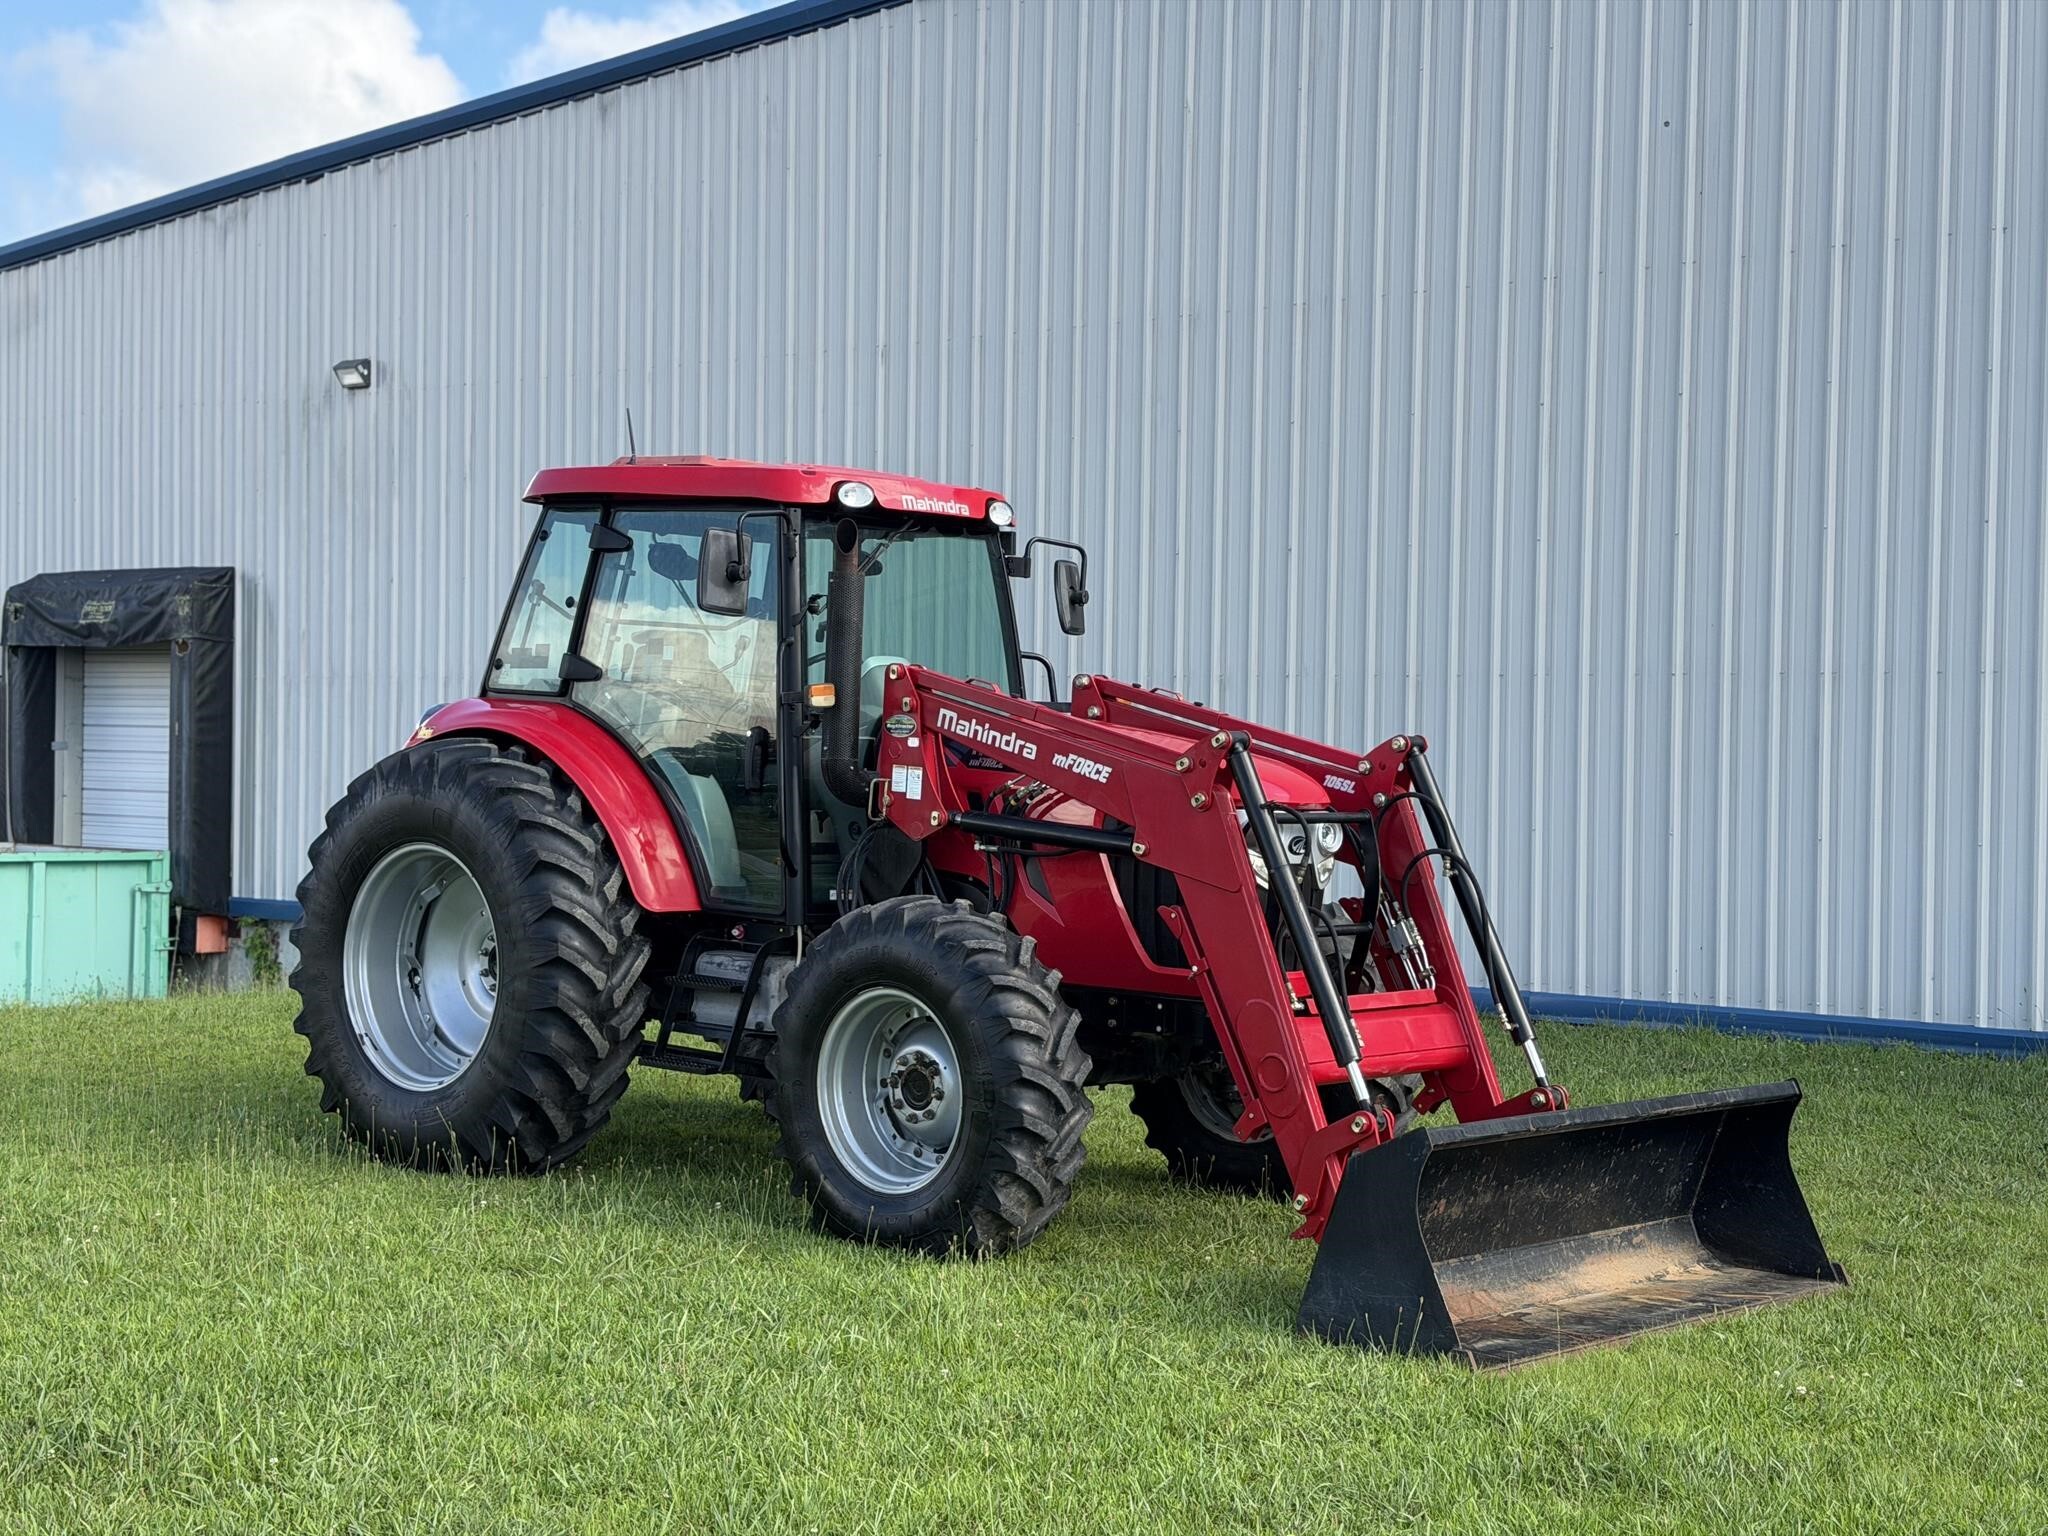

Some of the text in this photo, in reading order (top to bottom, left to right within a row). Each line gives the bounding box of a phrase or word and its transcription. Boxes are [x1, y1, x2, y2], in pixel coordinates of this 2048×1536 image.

[901, 494, 970, 516] Mahindra
[937, 707, 1113, 784] Mahindra mFORCE
